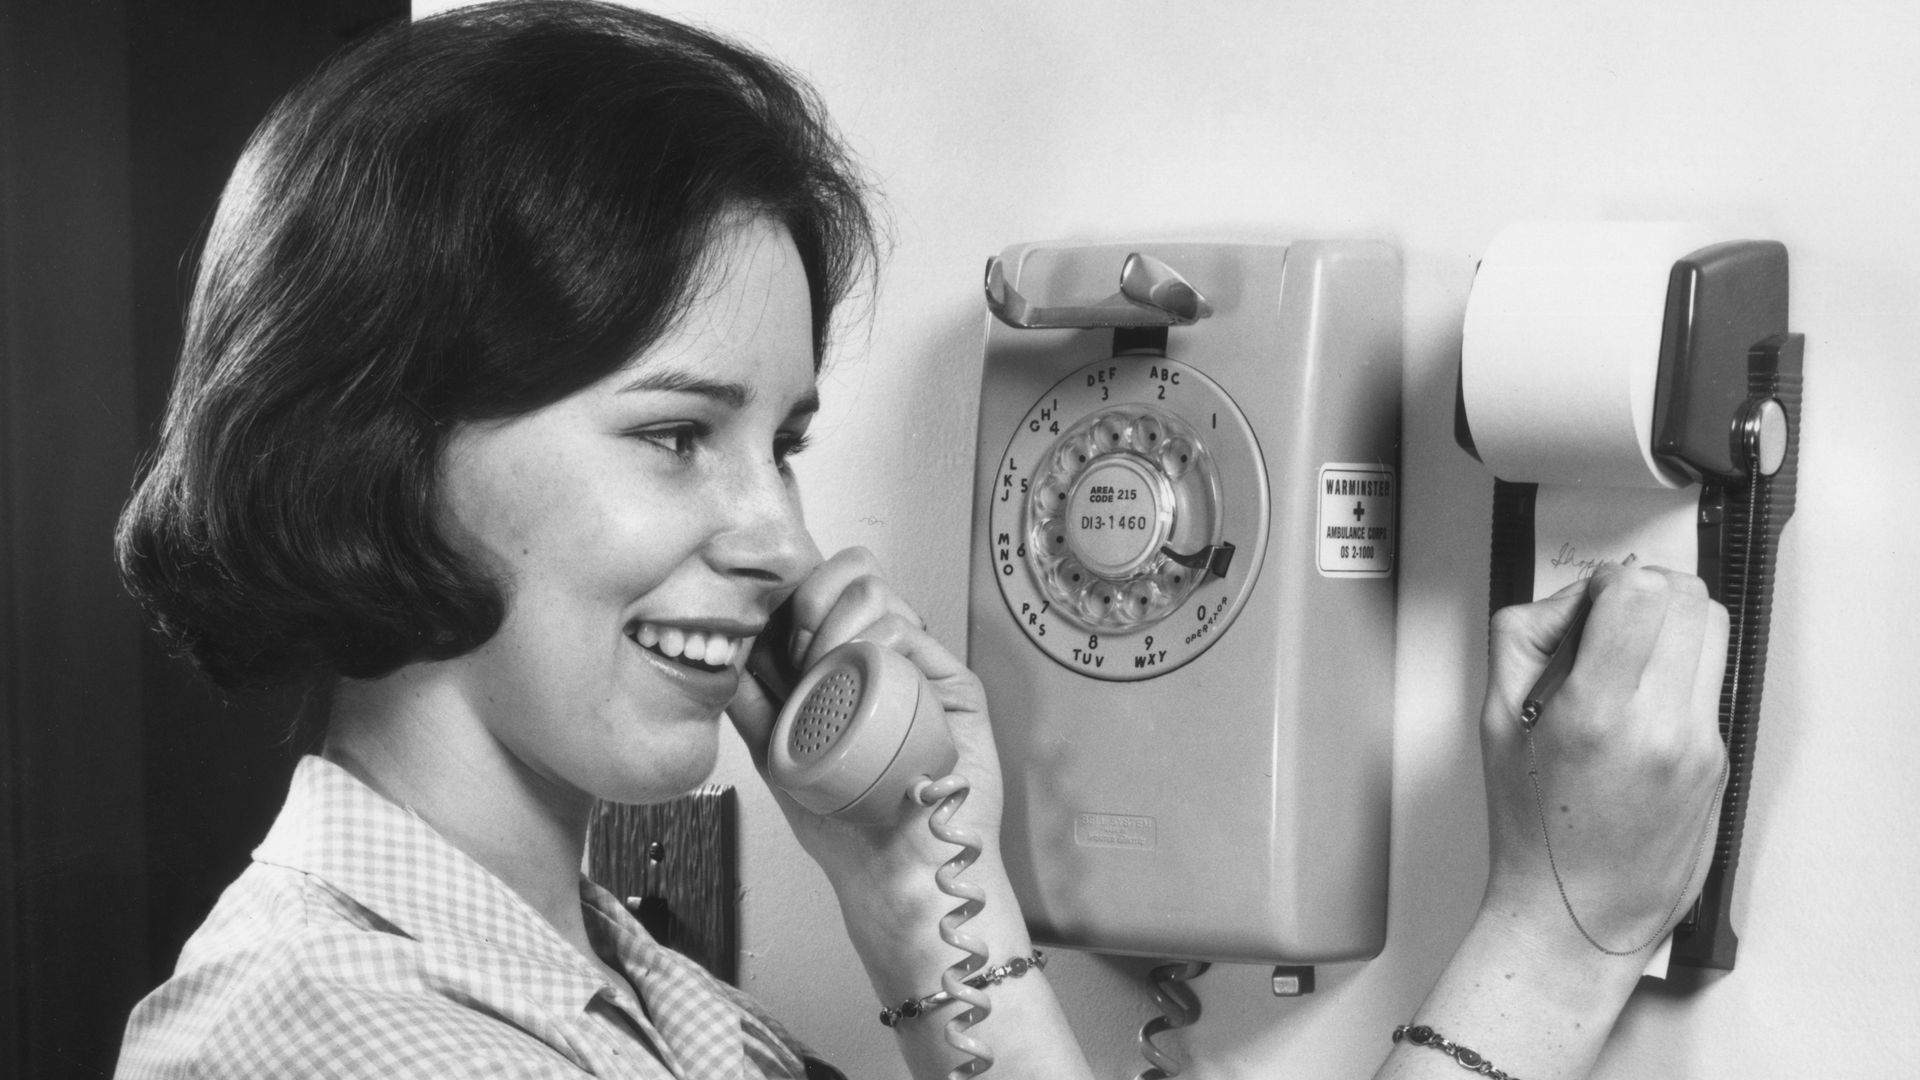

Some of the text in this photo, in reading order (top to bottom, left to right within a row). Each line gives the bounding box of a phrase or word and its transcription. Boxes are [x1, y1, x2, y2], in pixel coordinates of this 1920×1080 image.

[1087, 367, 1116, 387] DEF
[1149, 366, 1180, 385] ABC
[1101, 387, 1108, 401] 3
[1157, 385, 1165, 400] 2
[1050, 421, 1060, 435] 4
[1020, 479, 1029, 493] 5
[1090, 486, 1115, 495] AREA
[1326, 479, 1390, 496] WARMINSTER
[1089, 494, 1114, 503] CODE
[1117, 490, 1137, 500] 215
[1326, 526, 1365, 540] AMBULANCE
[1016, 544, 1026, 557] 6
[1340, 545, 1374, 559] OS 2-1000
[1041, 600, 1050, 615] 7
[1185, 596, 1228, 644] OPERATOR
[1088, 635, 1098, 650] 8
[1145, 636, 1153, 650] 9
[1073, 649, 1104, 668] TUV
[1135, 650, 1167, 668] WXY
